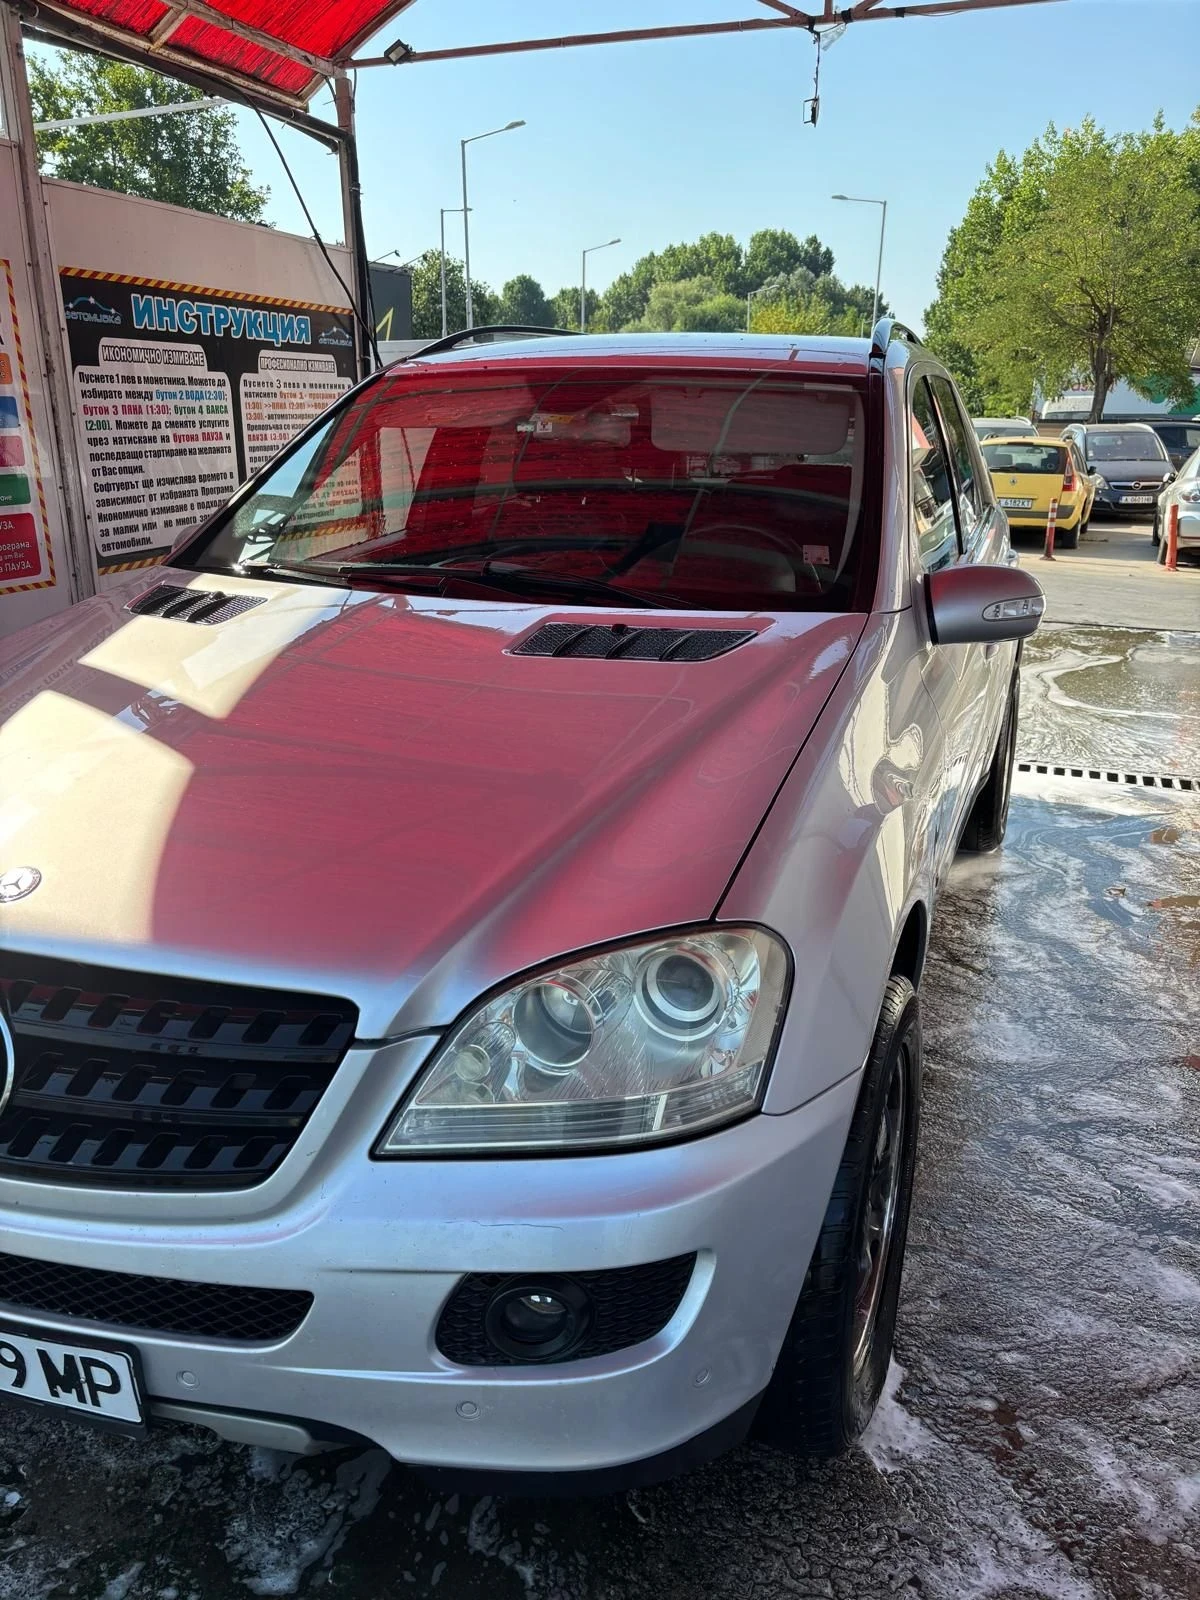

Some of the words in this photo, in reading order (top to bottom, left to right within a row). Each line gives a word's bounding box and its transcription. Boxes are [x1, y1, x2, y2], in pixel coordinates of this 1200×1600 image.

[131, 293, 311, 347] ИНСТРУКЦИЯ
[101, 345, 161, 364] ИКОНОМИЧНО
[162, 349, 205, 366] ИЗМИВАНЕ
[79, 372, 114, 384] Пуснете
[121, 375, 136, 384] лев
[137, 376, 142, 384] в
[144, 376, 187, 386] монетника.
[188, 376, 216, 386] Можете
[217, 378, 226, 388] да
[243, 379, 273, 389] Пуснете
[276, 379, 281, 389] 3
[284, 381, 300, 389] лева
[81, 388, 122, 400] избирате
[125, 390, 153, 401] между
[156, 389, 177, 401] бутон
[179, 390, 184, 400] 2
[244, 391, 277, 399] натиснете
[83, 404, 109, 416] бутон
[112, 405, 118, 415] 3
[122, 404, 143, 415] ПЯНА
[174, 405, 196, 415] бутон
[198, 405, 203, 415] 4
[206, 405, 228, 414] ВАКСА
[115, 420, 148, 430] Можете
[152, 421, 162, 431] да
[165, 420, 196, 429] сменяте
[199, 420, 229, 429] услугите
[87, 437, 109, 447] чрез
[112, 435, 157, 445] натискане
[161, 434, 170, 443] на
[173, 432, 199, 443] бутона
[202, 432, 223, 441] ПАУЗА
[226, 432, 230, 440] и
[90, 449, 143, 461] последващо
[144, 447, 187, 458] стартиране
[188, 447, 197, 456] на
[198, 446, 231, 455] желаната
[92, 467, 101, 477] от
[102, 466, 117, 476] Вас
[118, 465, 145, 475] опция.
[94, 480, 139, 493] Софтуерът
[142, 478, 154, 489] ще
[157, 474, 196, 487] изчислява
[198, 472, 227, 483] времето
[96, 494, 145, 508] зависимост
[148, 493, 157, 502] от
[160, 488, 198, 500] избраната
[97, 508, 148, 523] Икономично
[151, 503, 188, 516] измиване
[190, 503, 195, 511] е
[100, 528, 109, 538] за
[113, 524, 139, 536] малки
[142, 521, 157, 532] или
[164, 519, 173, 528] не
[175, 515, 197, 526] много
[101, 536, 153, 552] автомобили.
[36, 1348, 122, 1408] MP
